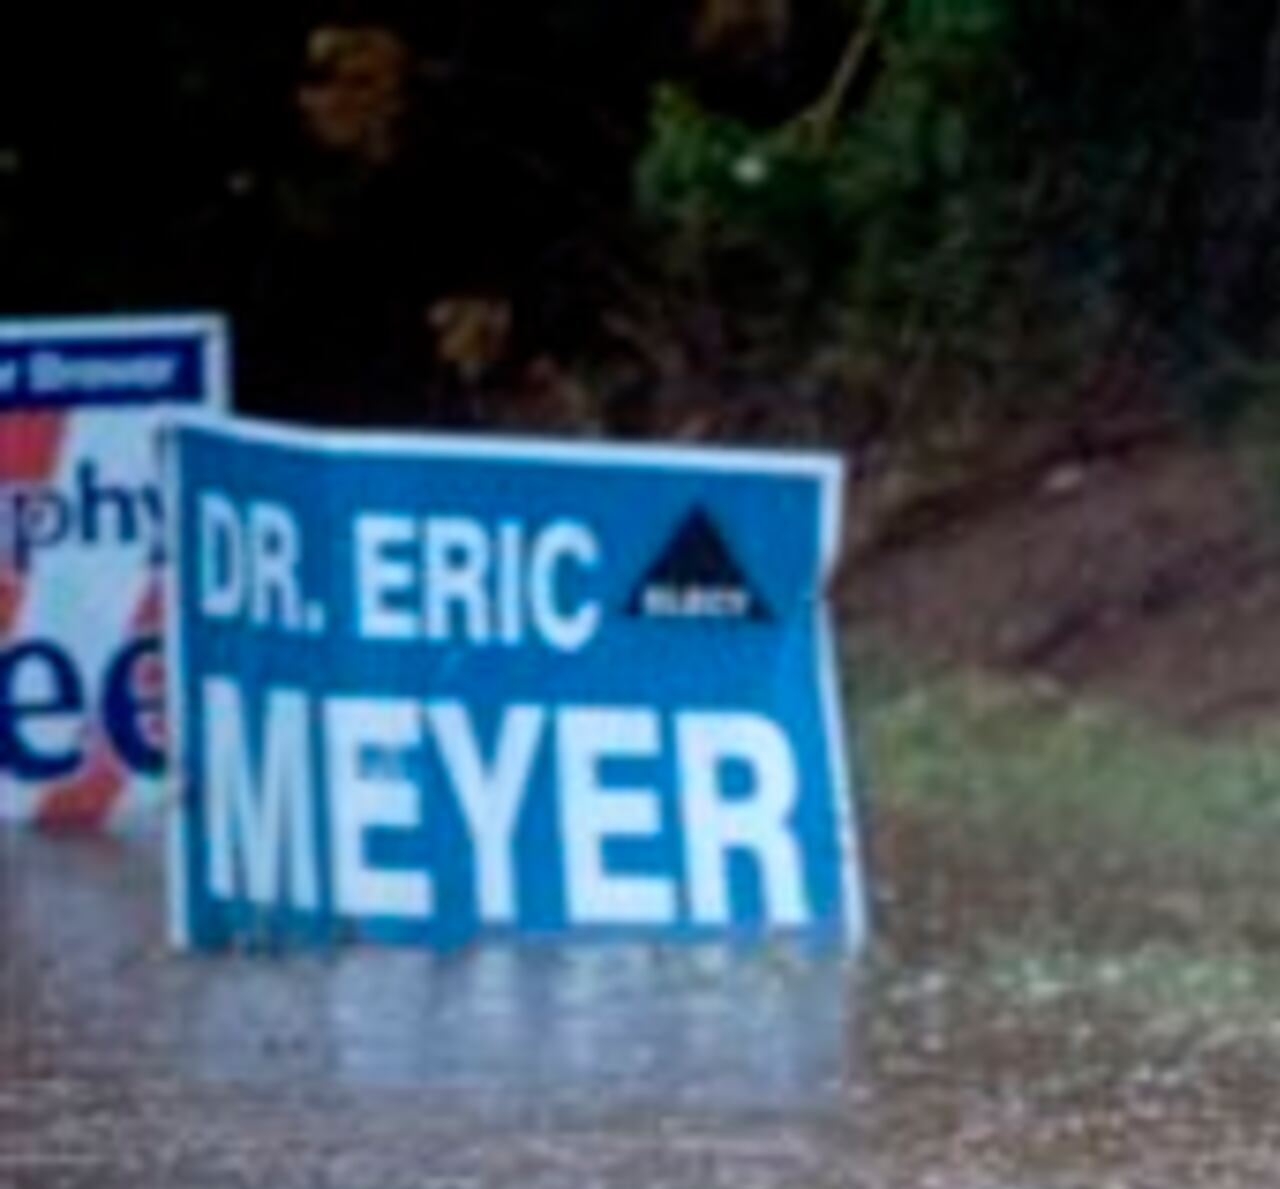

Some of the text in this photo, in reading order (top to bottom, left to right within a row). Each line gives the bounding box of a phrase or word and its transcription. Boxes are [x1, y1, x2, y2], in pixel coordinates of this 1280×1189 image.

[200, 491, 599, 652] DR. ERIC
[201, 676, 811, 924] MEYER
